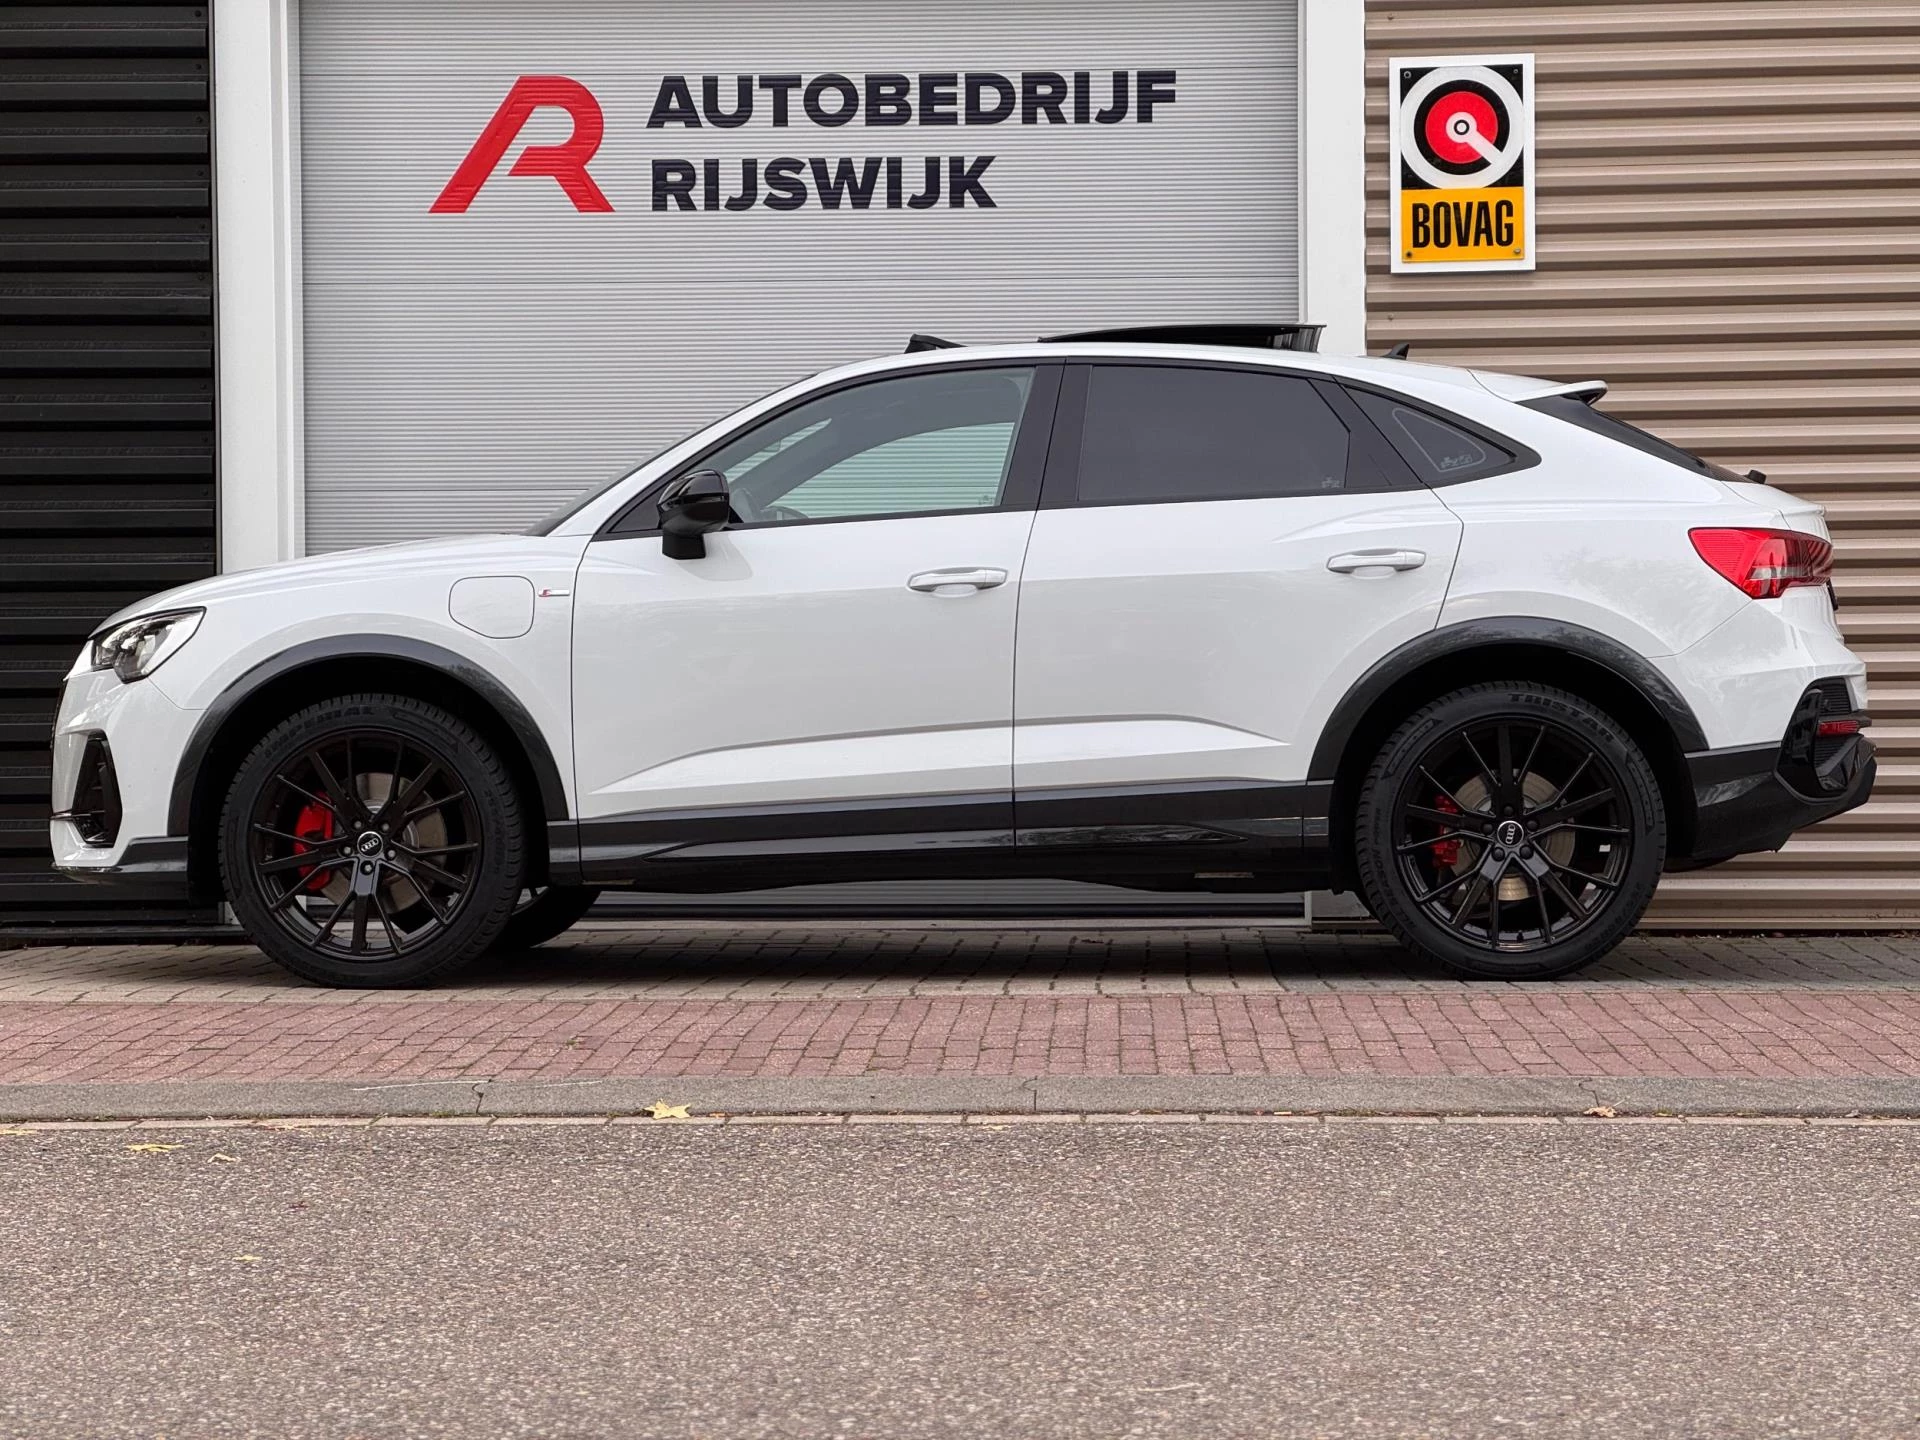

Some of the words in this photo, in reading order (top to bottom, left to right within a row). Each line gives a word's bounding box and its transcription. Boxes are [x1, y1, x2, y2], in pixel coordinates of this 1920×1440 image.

[647, 69, 1177, 129] AUTOBEDRIJF
[651, 155, 997, 212] RIJSWIJK
[1412, 199, 1514, 249] BOVAG
